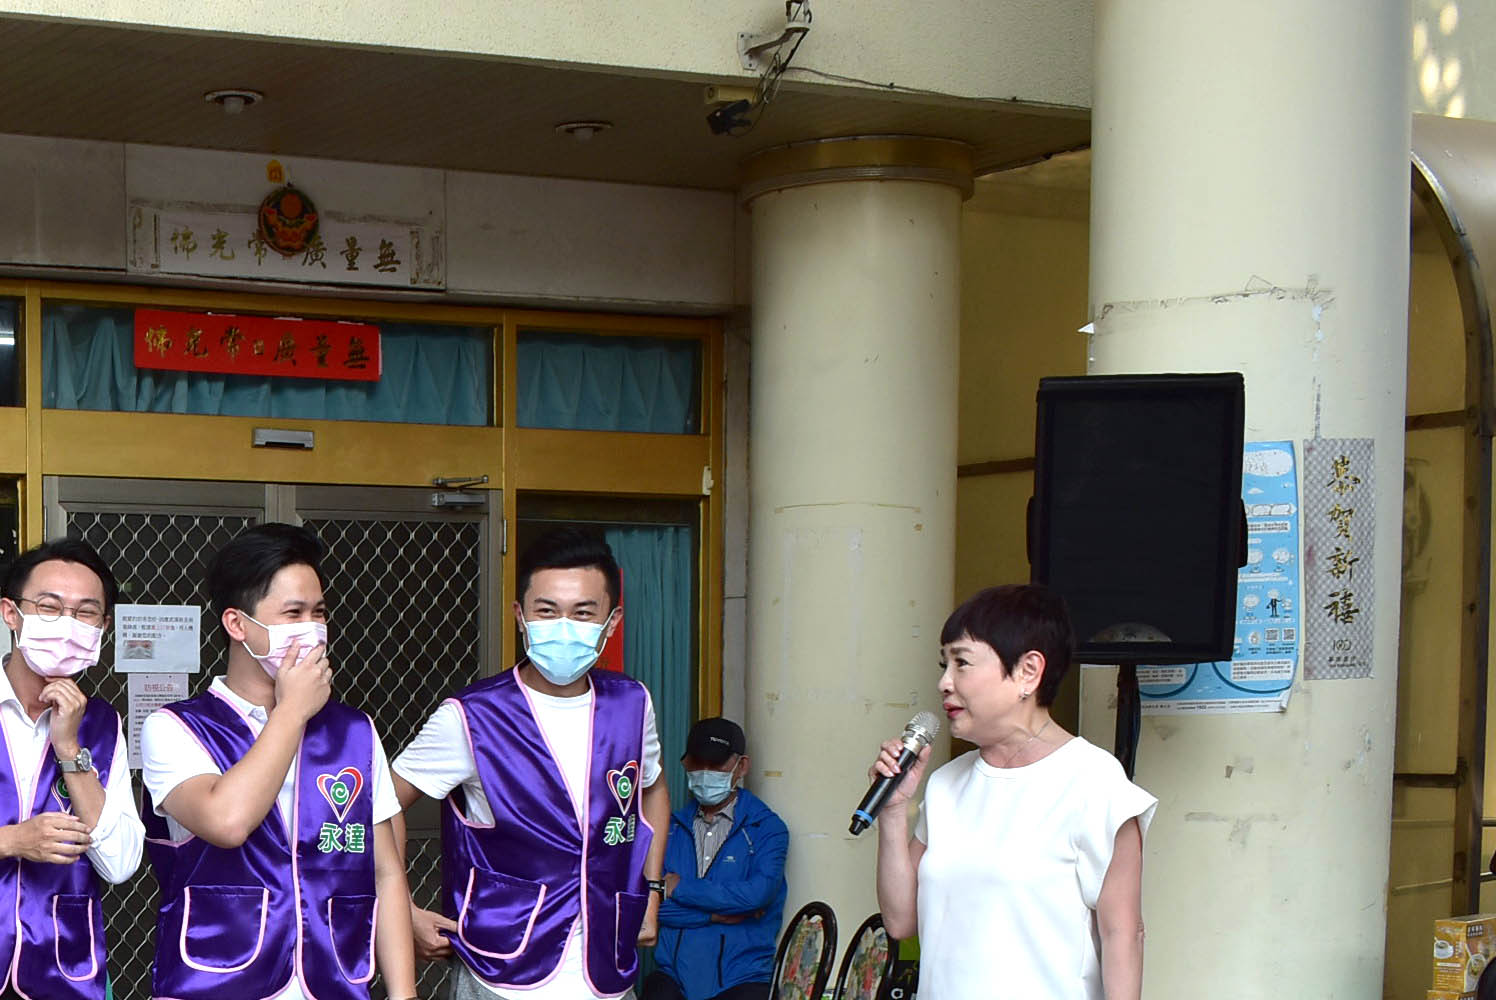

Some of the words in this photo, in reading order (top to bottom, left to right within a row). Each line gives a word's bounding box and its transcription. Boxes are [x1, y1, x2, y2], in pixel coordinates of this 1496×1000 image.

[1323, 454, 1361, 624] 恭賀新禧
[317, 822, 366, 854] 永達
